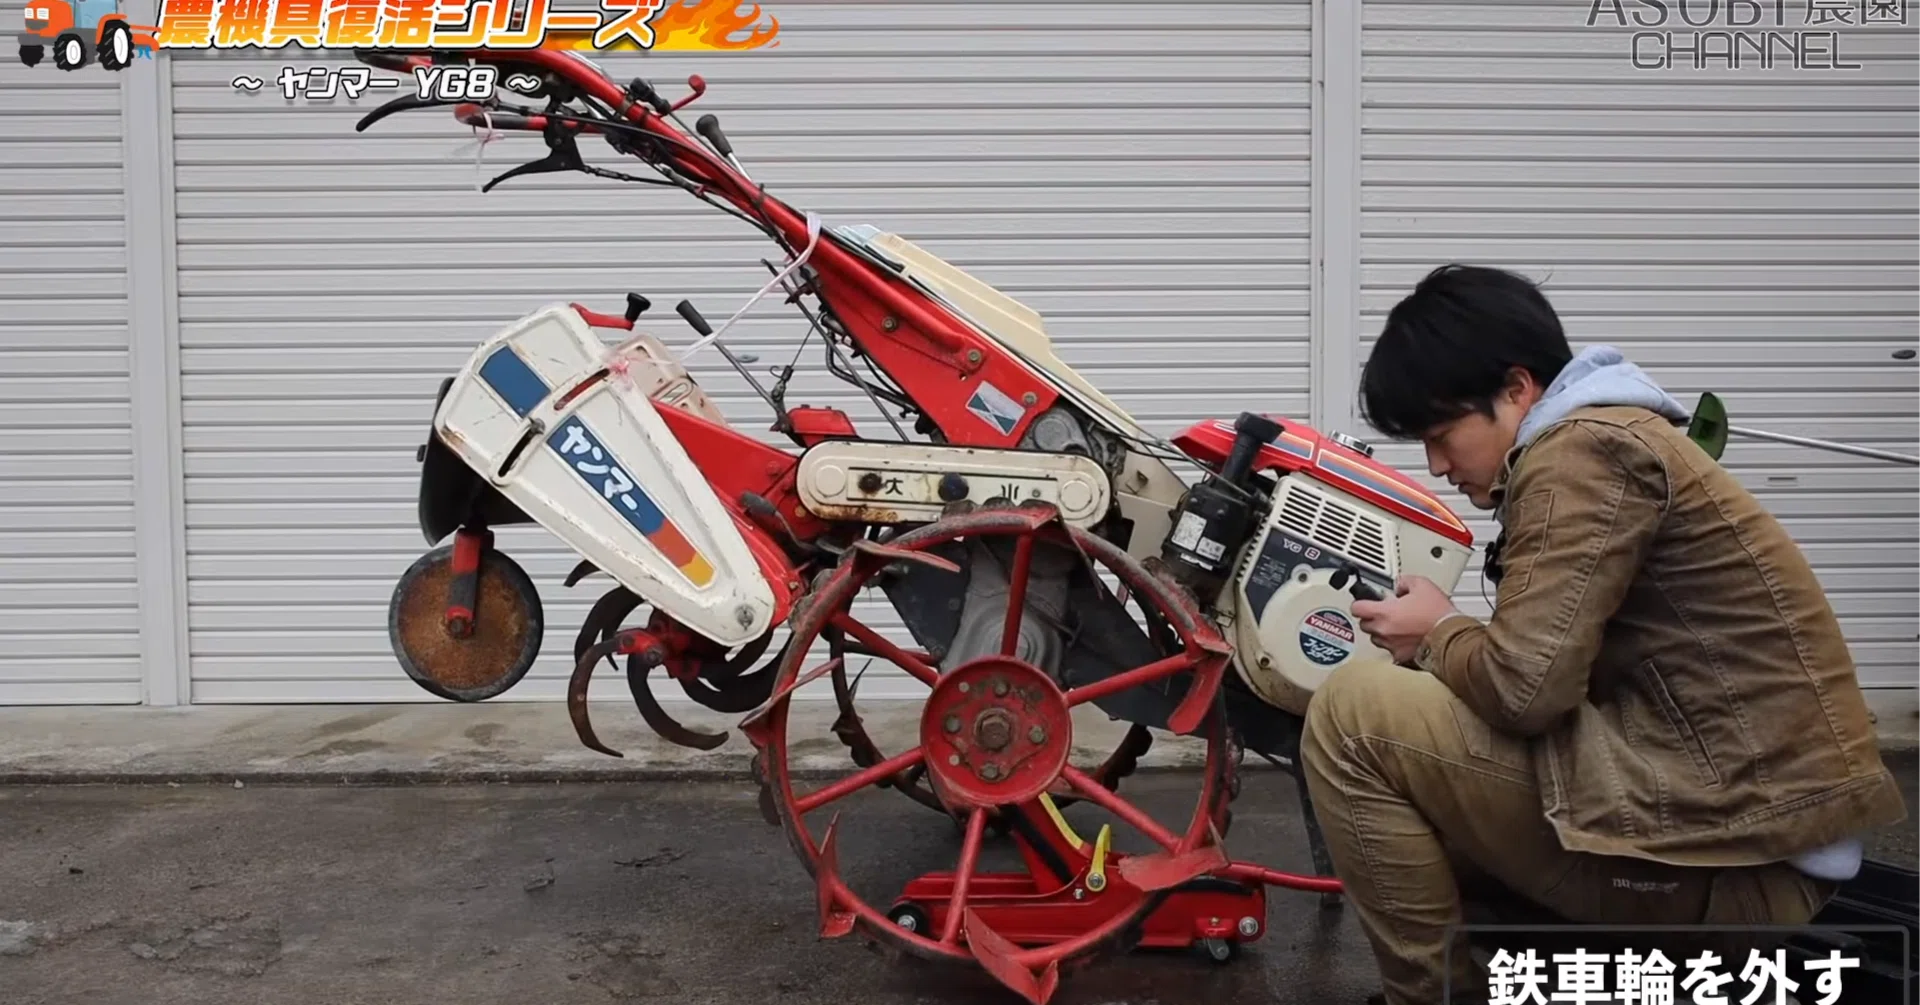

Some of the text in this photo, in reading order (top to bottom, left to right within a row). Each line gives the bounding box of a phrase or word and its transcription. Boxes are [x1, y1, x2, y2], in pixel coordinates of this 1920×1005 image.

[560, 425, 638, 510] ヤンマー
[1283, 538, 1321, 560] YG 8
[1310, 616, 1353, 640] YANMAR
